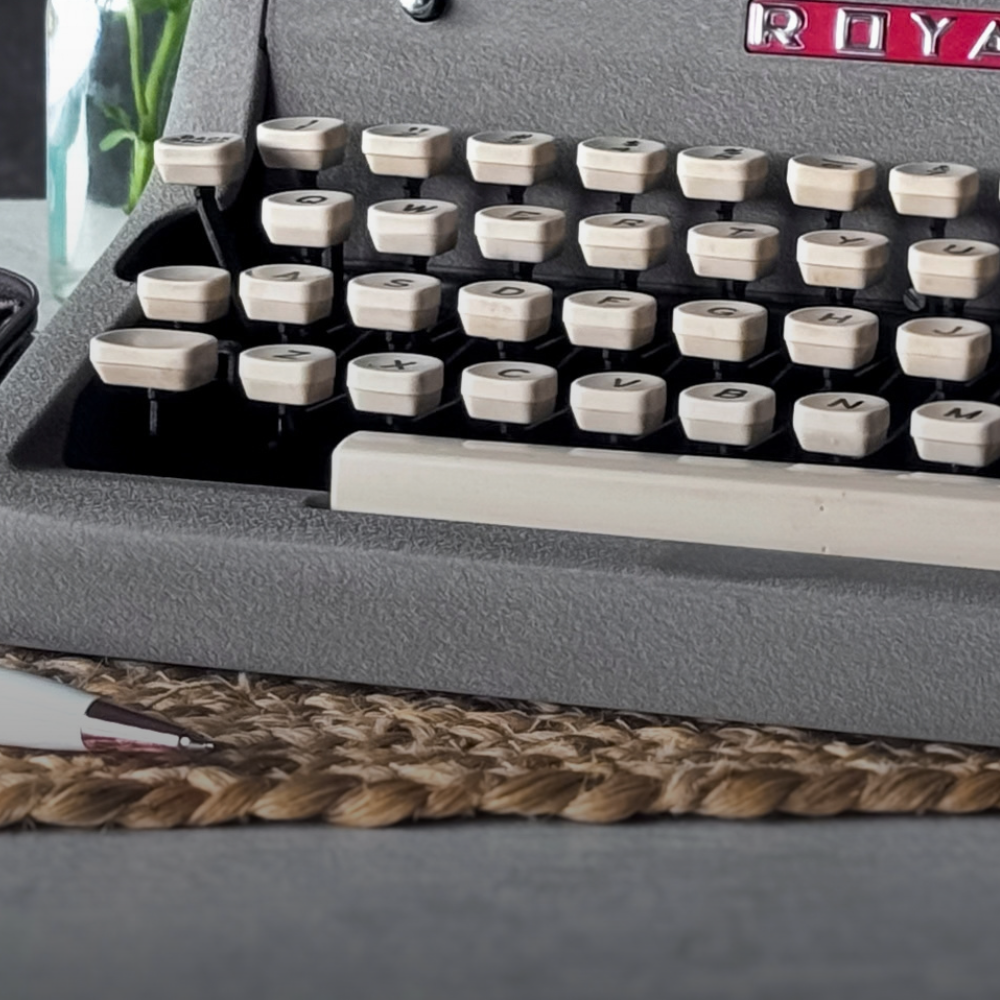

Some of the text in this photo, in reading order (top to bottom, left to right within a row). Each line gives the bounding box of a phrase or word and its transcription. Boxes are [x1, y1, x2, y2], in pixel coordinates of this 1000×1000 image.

[296, 195, 328, 204] Q
[402, 203, 438, 213] W
[508, 210, 542, 220] E
[613, 218, 645, 227] R
[729, 226, 756, 237] T
[839, 235, 866, 245] Y
[943, 244, 976, 255] U
[383, 278, 415, 288] S
[491, 286, 526, 296] D
[597, 295, 631, 305] F
[707, 307, 738, 317] G
[818, 312, 853, 323] H
[932, 325, 963, 335] J
[272, 349, 984, 420] Z X C V B N M
